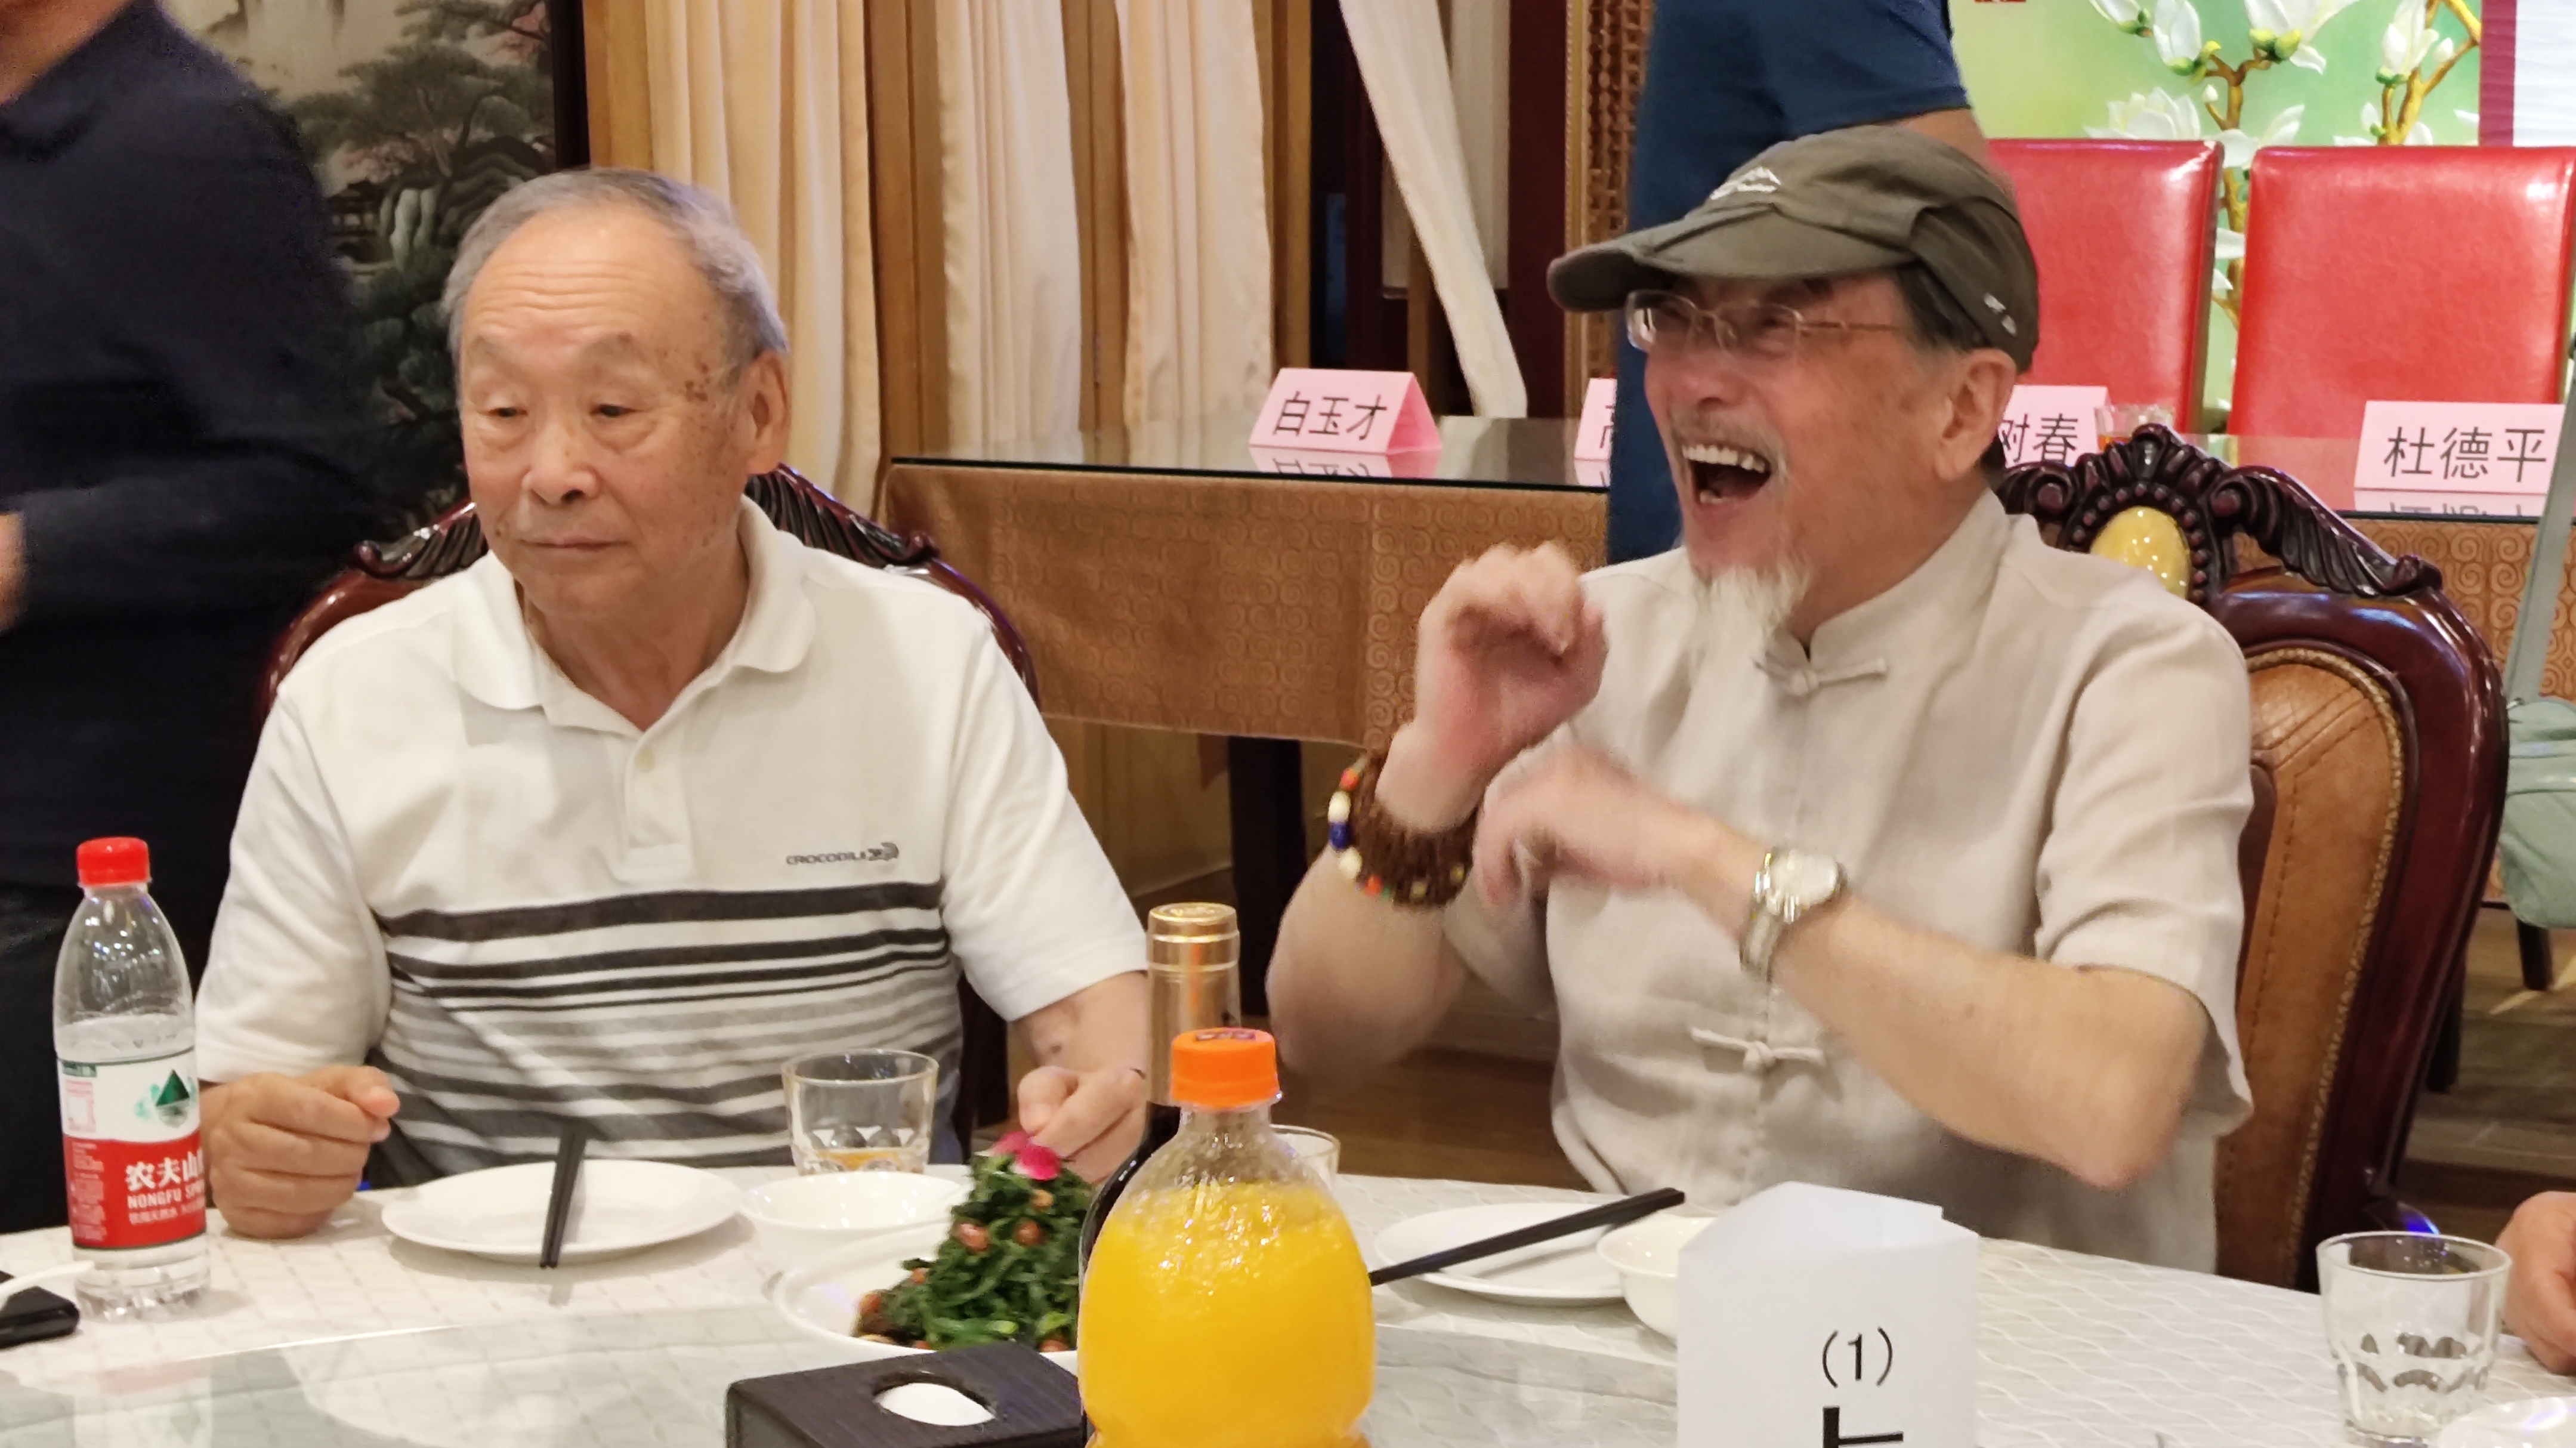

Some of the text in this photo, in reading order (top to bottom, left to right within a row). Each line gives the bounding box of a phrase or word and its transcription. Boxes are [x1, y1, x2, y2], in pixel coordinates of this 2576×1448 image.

[1272, 391, 1387, 441] 白玉才
[2384, 426, 2547, 483] 杜德平
[125, 1148, 204, 1191] 农夫山
[127, 1188, 182, 1209] NONGFU
[1823, 1327, 1893, 1388] (1)
